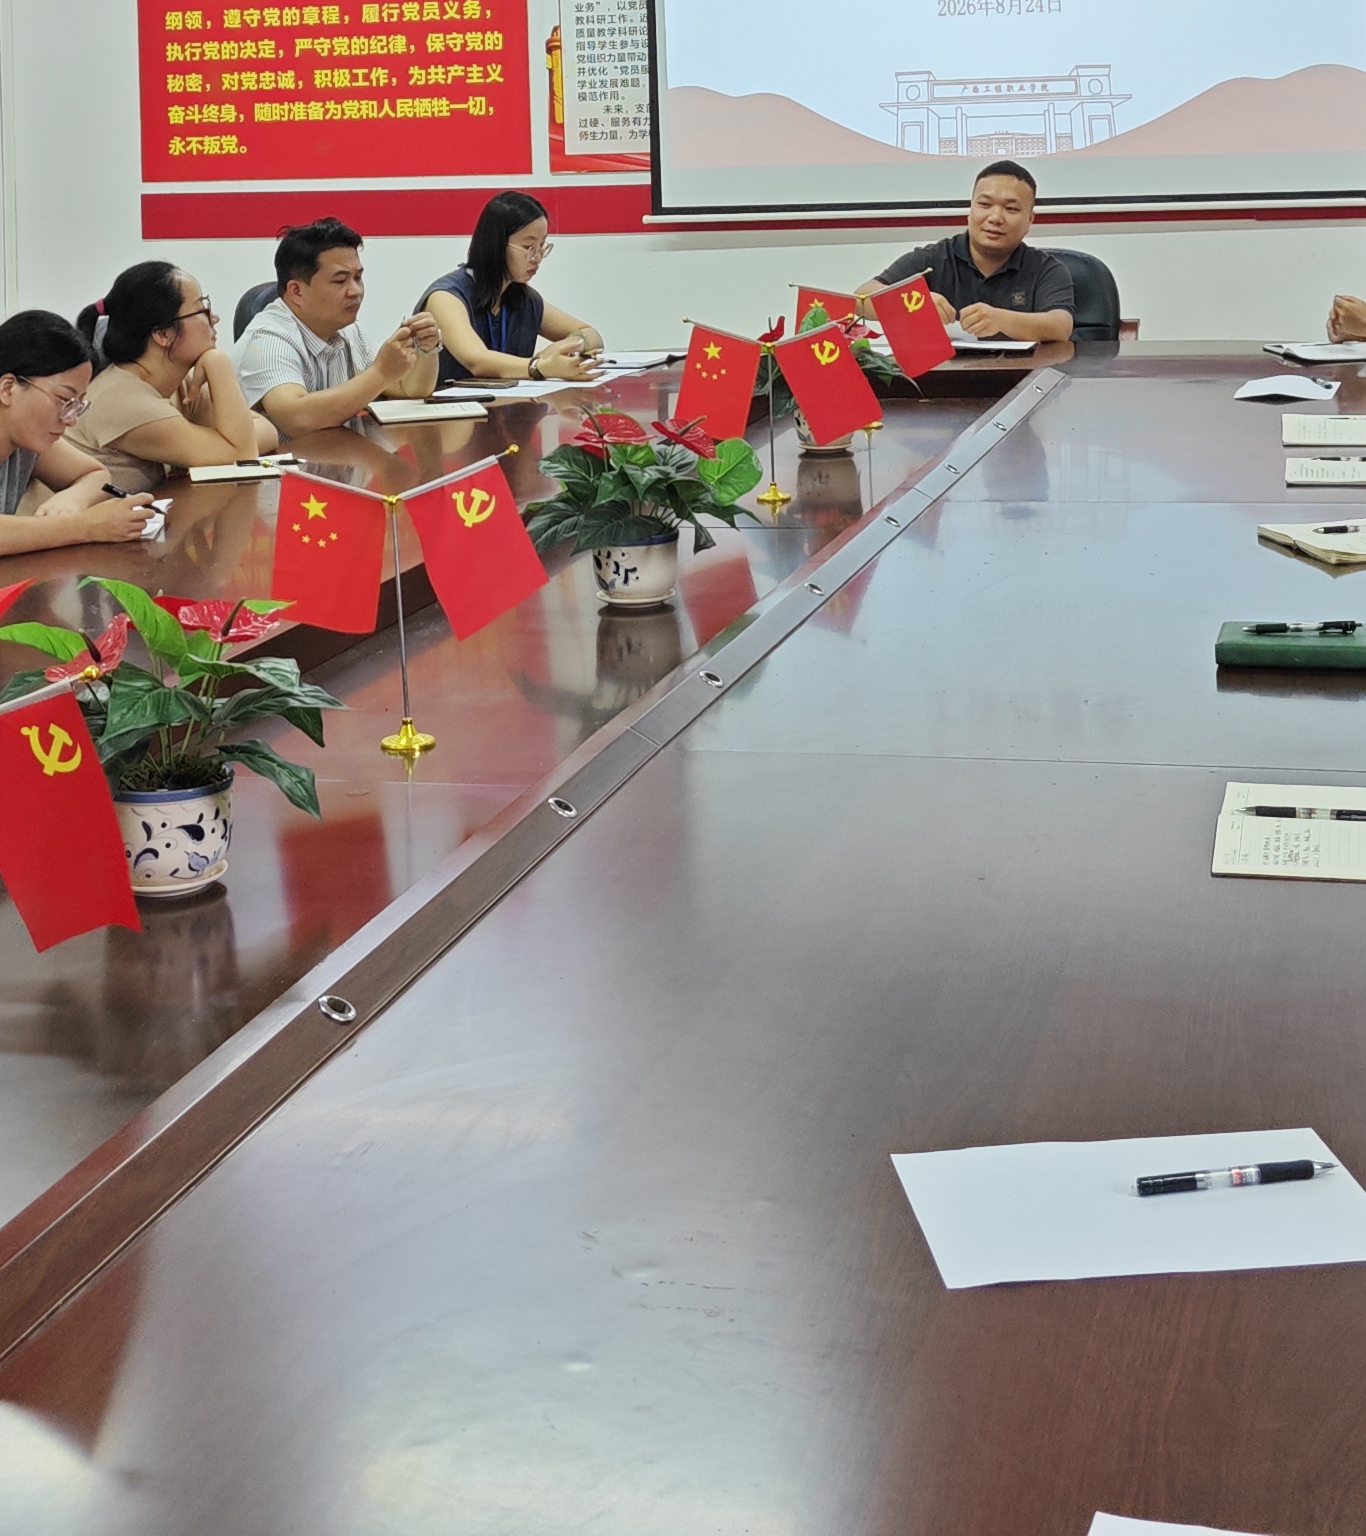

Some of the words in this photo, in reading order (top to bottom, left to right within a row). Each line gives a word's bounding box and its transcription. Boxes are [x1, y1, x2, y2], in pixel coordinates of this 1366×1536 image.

[165, 0, 493, 31] 纲领，遵守党的章程，履行党员义务，
[166, 31, 503, 63] 执行党的决定，严守党的纪律，保守党的
[167, 63, 504, 94] 秘密，对党忠诚，积极工作，为共产主义
[168, 96, 496, 126] 奋斗终身，随时准备为党和人民牺牲一切，
[169, 135, 248, 156] 永不叛党。
[579, 129, 650, 142] 师生力量，为学
